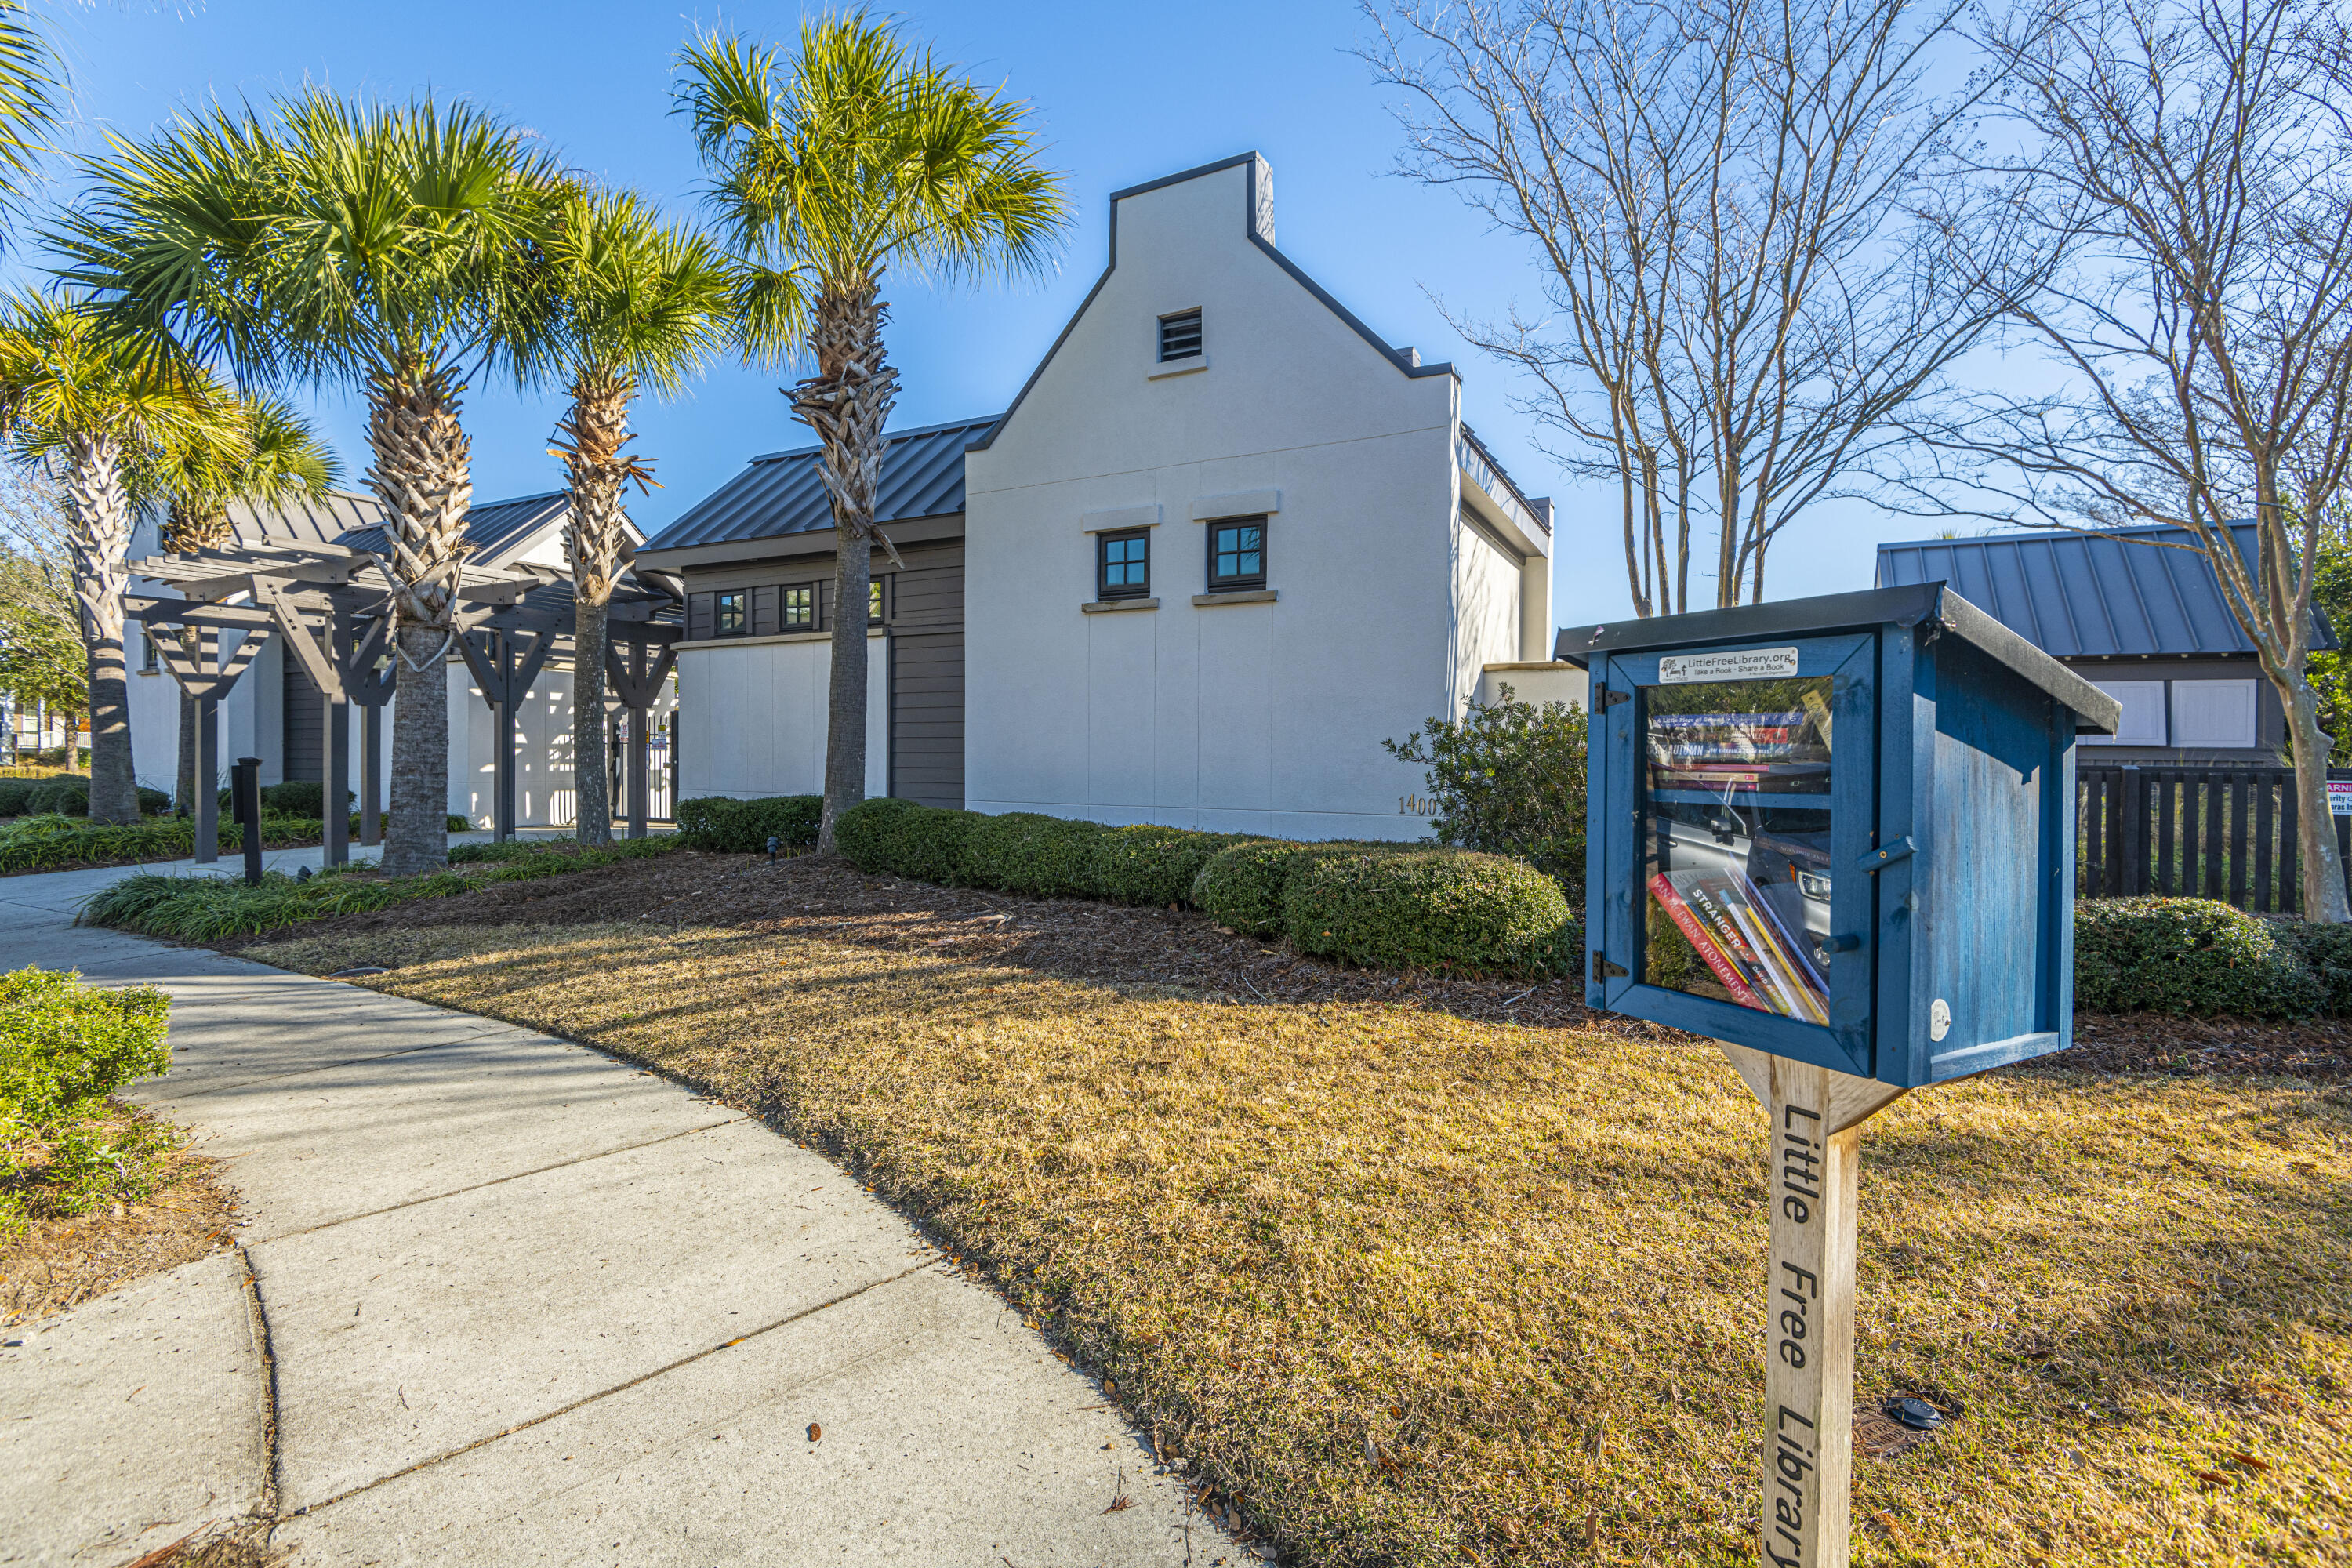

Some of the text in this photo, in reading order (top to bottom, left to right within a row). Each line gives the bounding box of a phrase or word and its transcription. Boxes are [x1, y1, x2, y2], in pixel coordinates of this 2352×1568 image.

[1688, 654, 1791, 668] LittleFreeLibrary.org
[1398, 793, 1436, 816] 1400
[1653, 879, 1671, 898] IAN
[1699, 941, 1751, 1002] ATONEMENT
[1693, 889, 1741, 948] STRANGER
[1751, 965, 1769, 985] DAVID
[1766, 983, 1788, 1010] BERGEN
[1783, 1104, 1821, 1224] Little
[1779, 1261, 1817, 1369] Free
